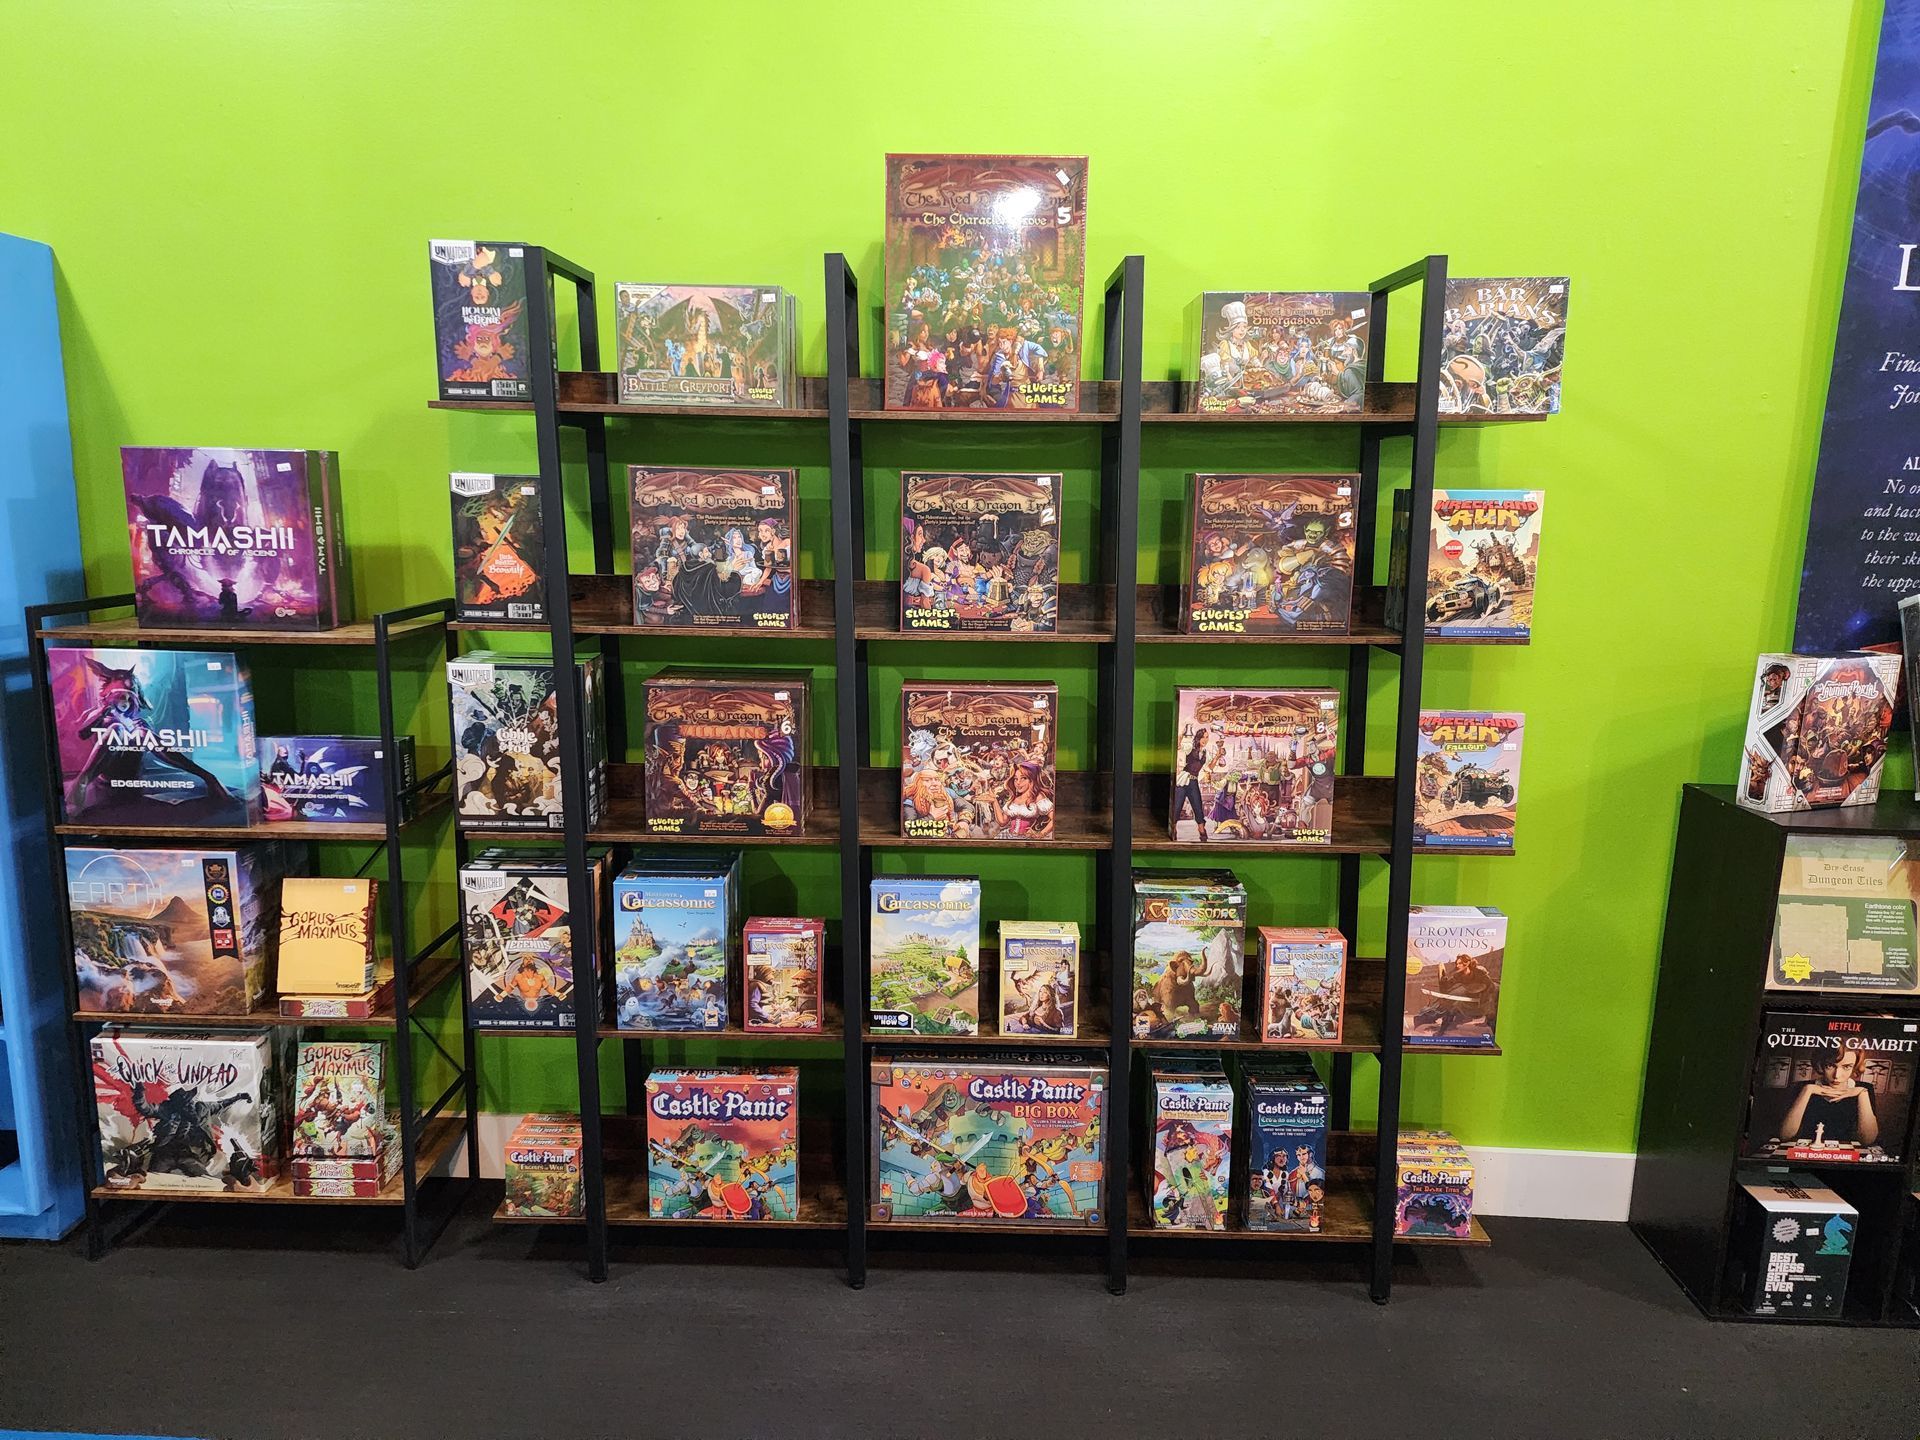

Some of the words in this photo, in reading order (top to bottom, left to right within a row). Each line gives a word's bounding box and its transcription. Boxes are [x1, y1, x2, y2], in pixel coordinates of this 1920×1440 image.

[904, 192, 938, 206] The
[940, 189, 971, 211] Red
[922, 212, 946, 225] The
[1056, 206, 1072, 225] 5
[1477, 287, 1526, 302] BAR
[1252, 315, 1323, 327] Smorgasbox
[1445, 302, 1560, 327] BARIANS
[628, 378, 667, 392] BATTLE
[680, 379, 730, 394] GREYPORT
[1018, 383, 1072, 394] SLUGFEST
[1025, 393, 1066, 405] GAMES
[455, 479, 490, 492] UNMATCHED
[1883, 479, 1906, 494] No
[640, 494, 665, 505] The
[669, 491, 698, 508] Red
[702, 494, 752, 510] Dragon
[756, 496, 781, 508] Inn
[911, 500, 936, 510] The
[942, 497, 969, 513] Red
[973, 498, 1022, 514] Dragon
[1205, 500, 1231, 513] The
[1434, 500, 1538, 515] WRECKLAND
[1042, 508, 1054, 524] 2
[1864, 503, 1893, 518] and
[1338, 512, 1352, 527] 3
[1449, 509, 1521, 530] RUN
[147, 524, 294, 550] TAMASHII
[314, 506, 326, 575] TAMASHII
[1860, 528, 1874, 541] to
[1878, 527, 1900, 541] the
[168, 548, 215, 556] CHRONICLE
[242, 549, 277, 557] ASCEND
[1865, 550, 1900, 565] their
[1862, 573, 1884, 588] the
[906, 608, 956, 619] SLUGFEST
[1192, 610, 1251, 621] SLUGFEST
[758, 620, 785, 628] GAMES
[912, 618, 948, 628] GAMES
[1198, 622, 1246, 632] GAMES
[452, 670, 490, 682] UNMATCHED
[652, 709, 677, 721] The
[681, 706, 709, 722] Red
[714, 709, 762, 724] Dragon
[911, 712, 936, 724] The
[941, 711, 968, 727] Red
[973, 712, 1019, 726] Dragon
[1196, 712, 1219, 724] The
[1223, 712, 1248, 724] Red
[1252, 712, 1294, 724] Dragon
[679, 726, 767, 739] VILLAINS
[781, 720, 791, 734] 6
[938, 727, 956, 736] The
[961, 727, 996, 736] Tavern
[998, 727, 1022, 736] Crew
[1032, 724, 1046, 741] 7
[1316, 722, 1324, 733] 8
[91, 728, 208, 748] TAMASHII
[496, 728, 538, 744] Cobble
[1431, 726, 1501, 746] RUN
[110, 780, 194, 788] EDGERUNNERS
[272, 772, 353, 786] TAMASHII
[904, 820, 949, 828] SLUGFEST
[910, 828, 945, 837] GAMES
[1824, 864, 1864, 872] Dry-Erase
[464, 876, 503, 890] UNMATCHED
[1808, 874, 1853, 886] Dungeon
[1857, 876, 1883, 886] Tiles
[70, 882, 164, 904] EARTH
[622, 892, 715, 911] Carcassonne
[879, 894, 972, 912] Carcassonne
[1149, 902, 1237, 918] Carcassonne
[291, 912, 334, 927] GORUS
[298, 922, 358, 938] MAXIMUS
[1418, 926, 1486, 937] PROVING
[507, 940, 550, 950] LEGENDS
[1414, 938, 1488, 950] GROUNDS
[1828, 1022, 1862, 1032] NETFLIX
[1767, 1034, 1841, 1048] QUEEN'S
[1846, 1036, 1918, 1052] GAMBIT
[304, 1046, 352, 1064] GORUS
[116, 1056, 165, 1087] QUICK
[178, 1055, 238, 1090] UNDEAD
[313, 1059, 376, 1076] MAXIMUS
[970, 1078, 1027, 1100] Castle
[1030, 1078, 1084, 1100] Panic
[653, 1092, 720, 1116] Castle
[722, 1092, 788, 1116] Panic
[1160, 1097, 1196, 1111] Castle
[1196, 1098, 1230, 1112] Panic
[1258, 1102, 1292, 1115] Castle
[1294, 1102, 1325, 1115] Panic
[1014, 1105, 1041, 1118] BIG
[1046, 1106, 1079, 1119] BOX
[511, 1152, 541, 1163] Castle
[542, 1152, 572, 1163] Panic
[1402, 1172, 1436, 1184] Castle
[1438, 1172, 1470, 1185] Panic
[1770, 1252, 1798, 1263] BEST
[1768, 1262, 1805, 1273] CHESS
[1766, 1272, 1788, 1282] SET
[1764, 1282, 1794, 1292] EVER
